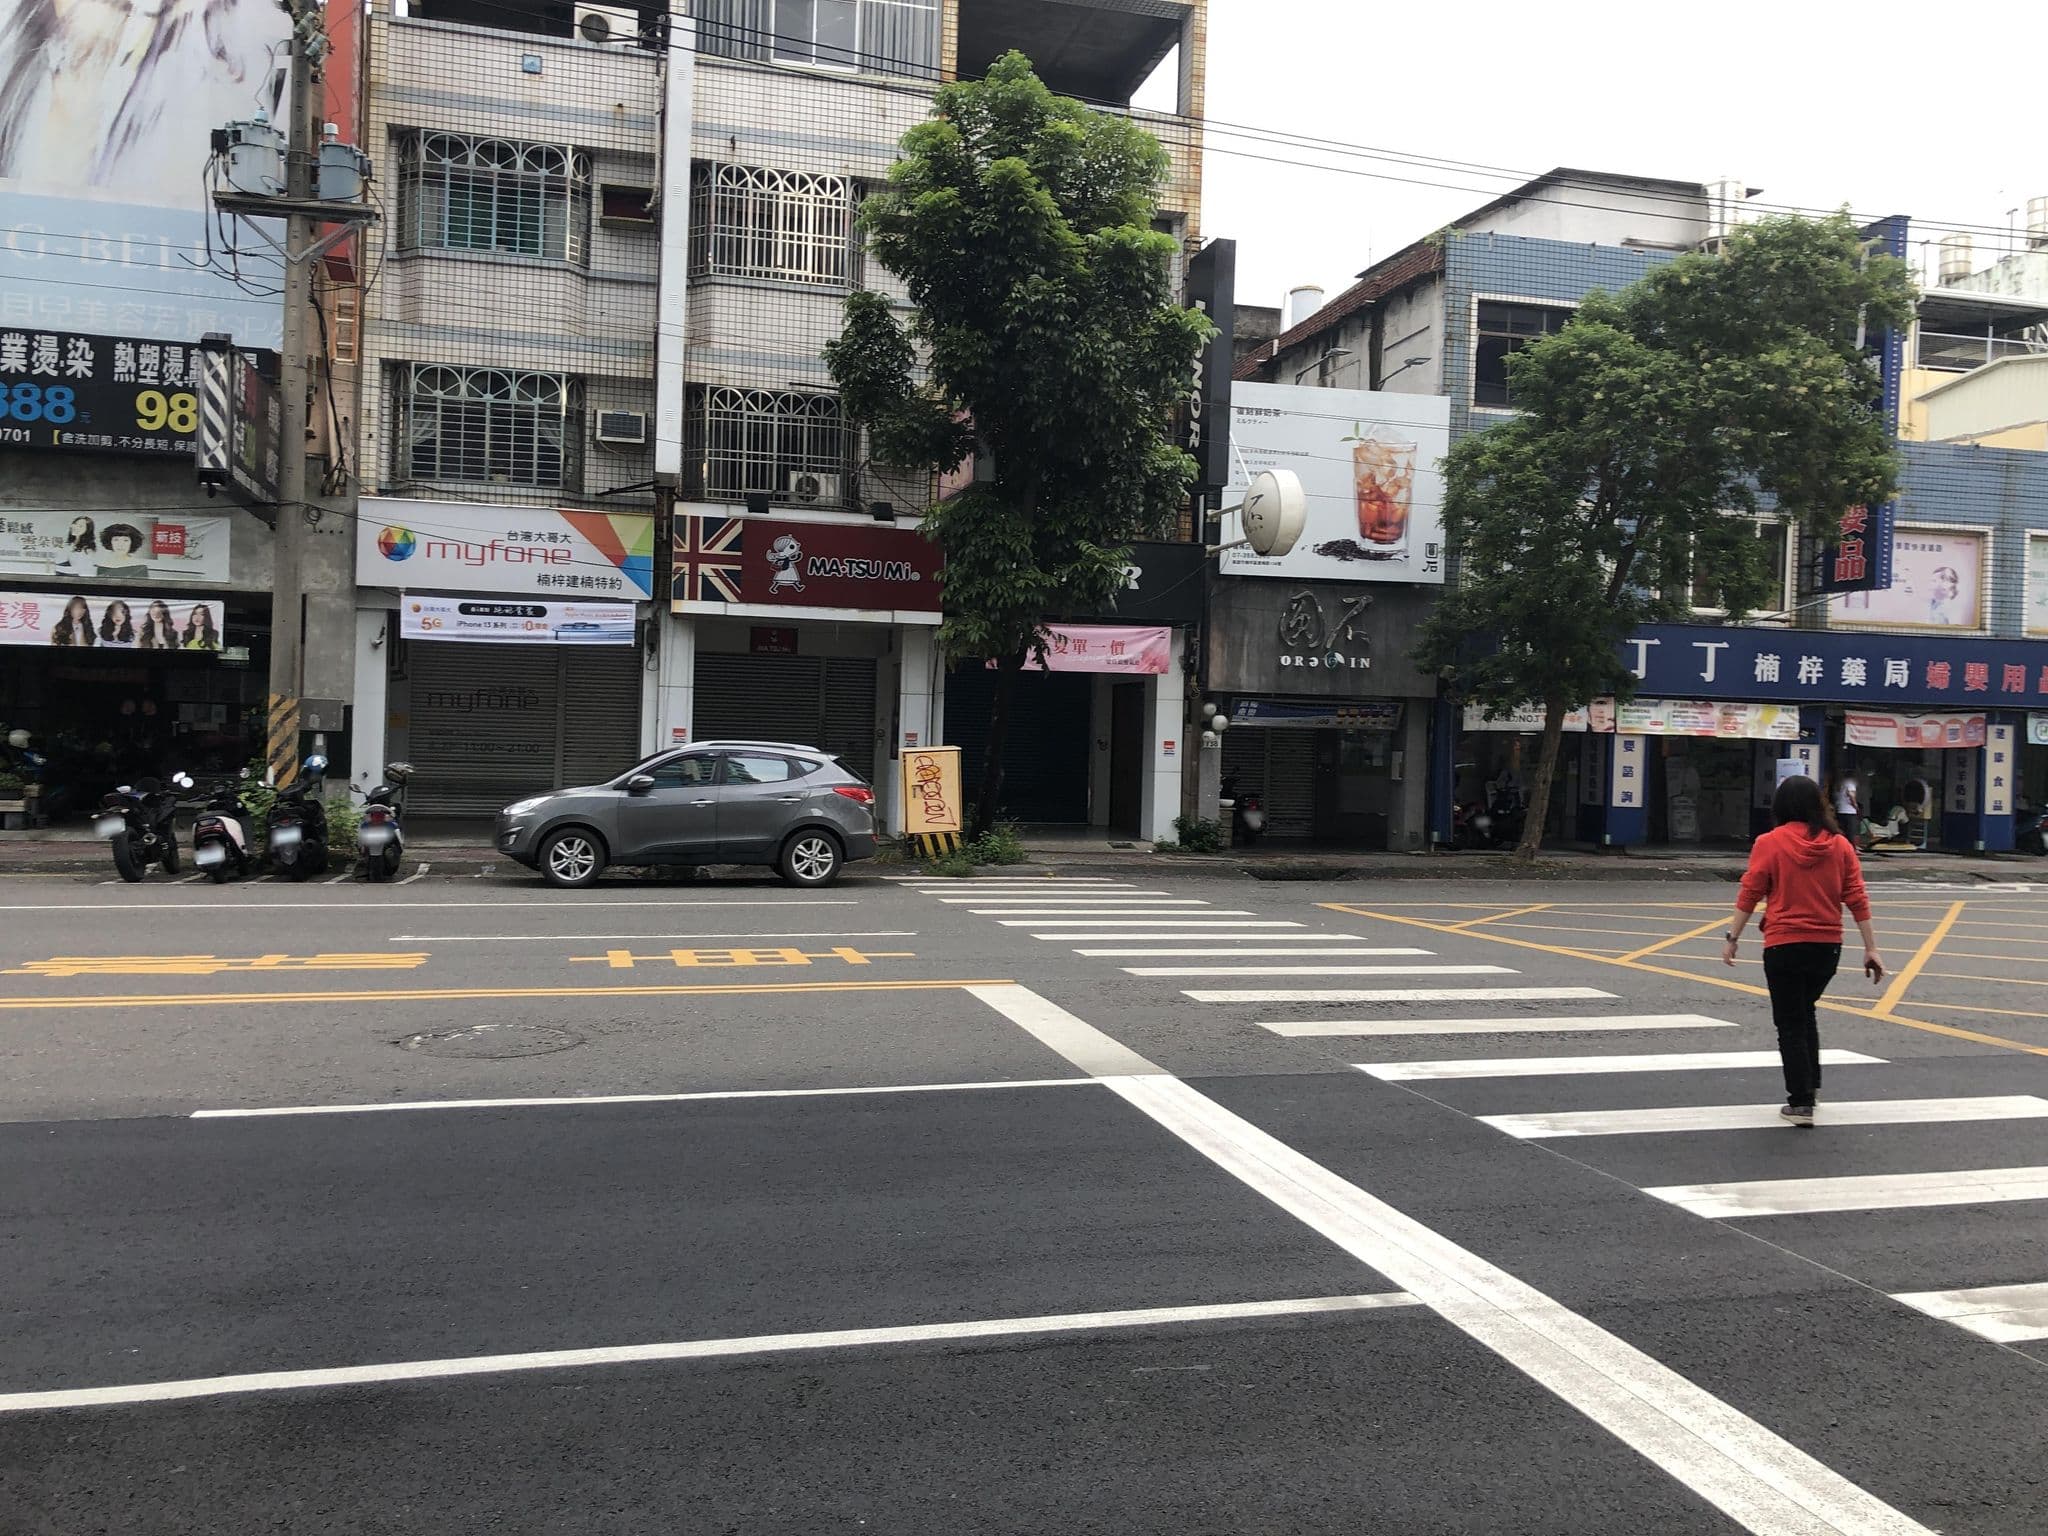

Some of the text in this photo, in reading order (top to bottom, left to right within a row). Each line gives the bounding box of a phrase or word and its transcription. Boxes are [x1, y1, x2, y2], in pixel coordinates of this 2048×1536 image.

[0, 381, 75, 424] 88
[0, 427, 31, 442] 701
[507, 530, 572, 544] 台灣大哥大
[426, 539, 571, 566] myfone
[537, 573, 623, 590] 楠梓建楠特約
[421, 616, 442, 630] 5G
[457, 620, 482, 628] iPhone
[1044, 638, 1126, 656] 夏單一價
